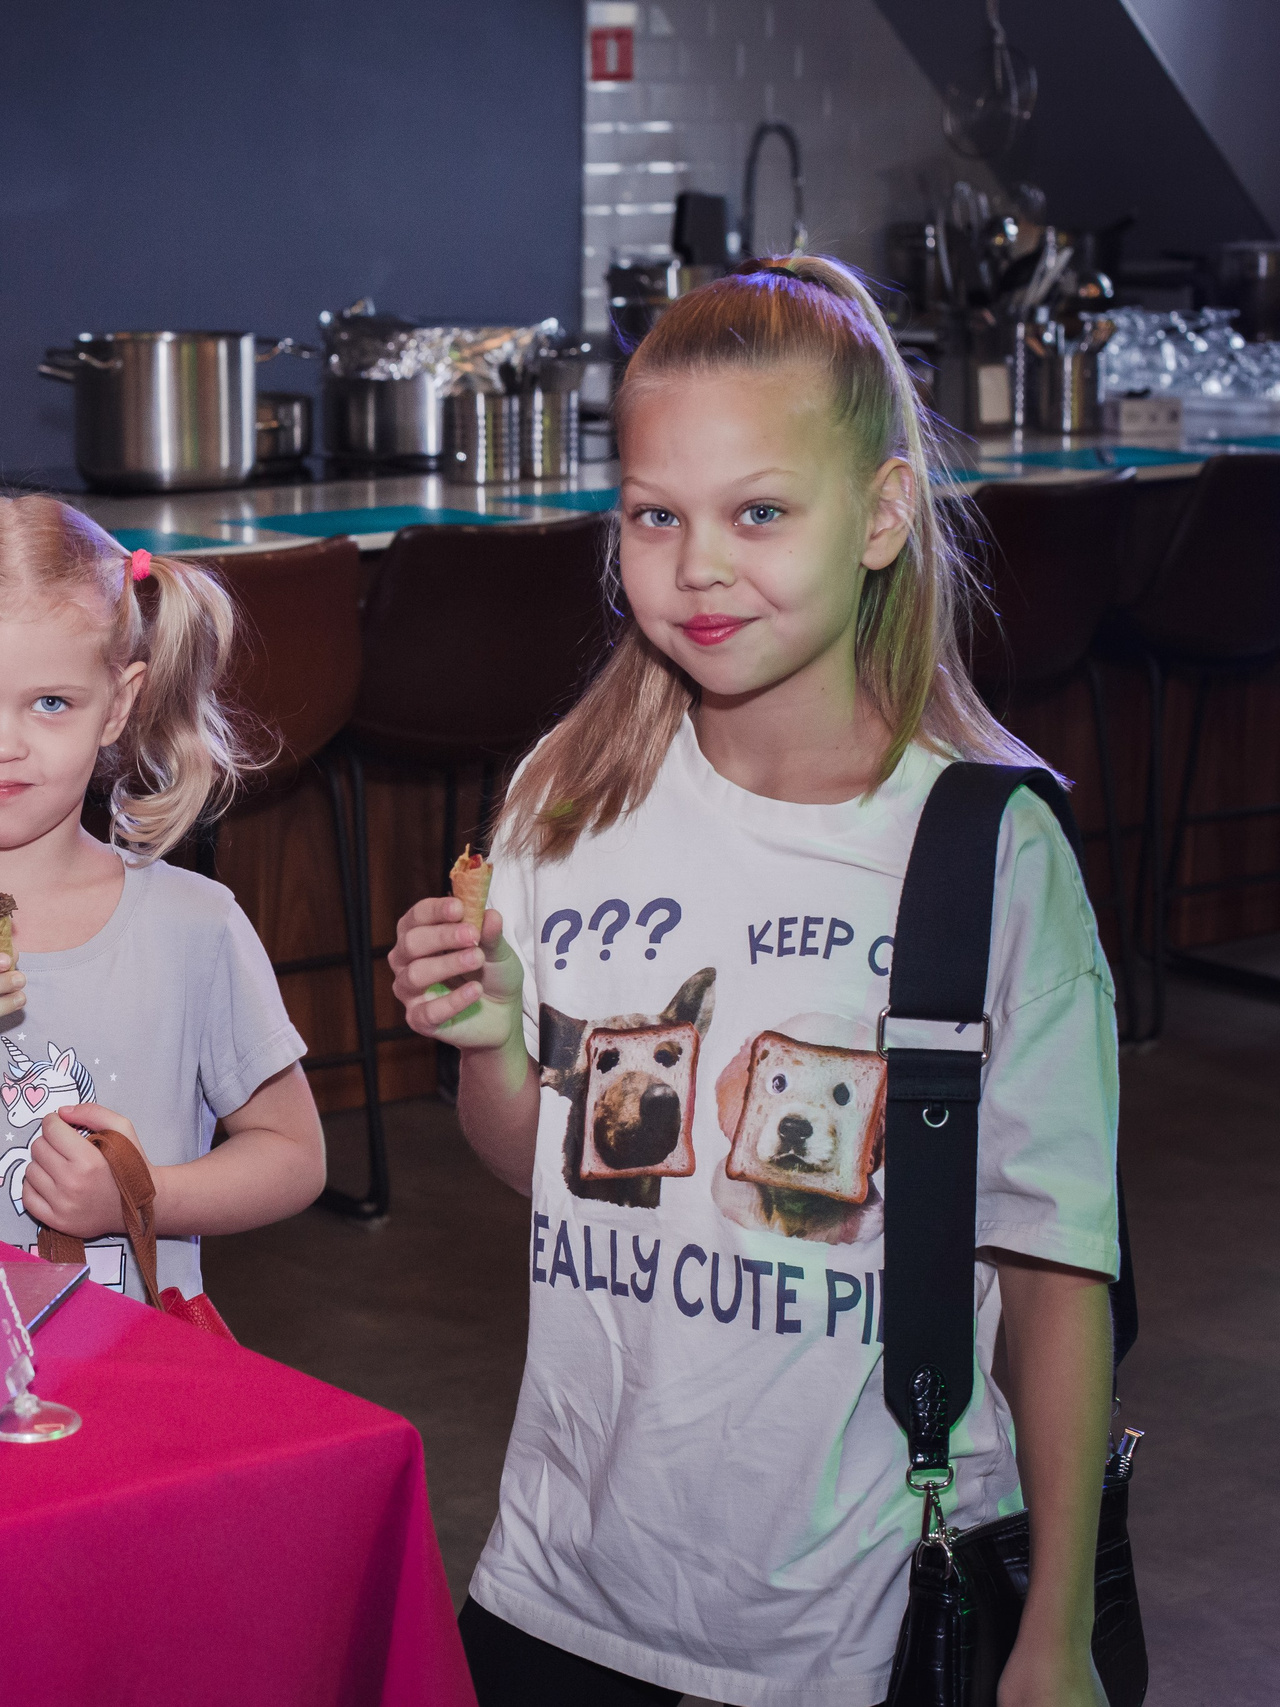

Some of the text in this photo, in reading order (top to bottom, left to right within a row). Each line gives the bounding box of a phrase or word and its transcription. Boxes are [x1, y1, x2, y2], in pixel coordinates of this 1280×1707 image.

[748, 916, 894, 977] KEEP C
[532, 1210, 661, 1304] EALLY
[673, 1243, 804, 1336] CUTE
